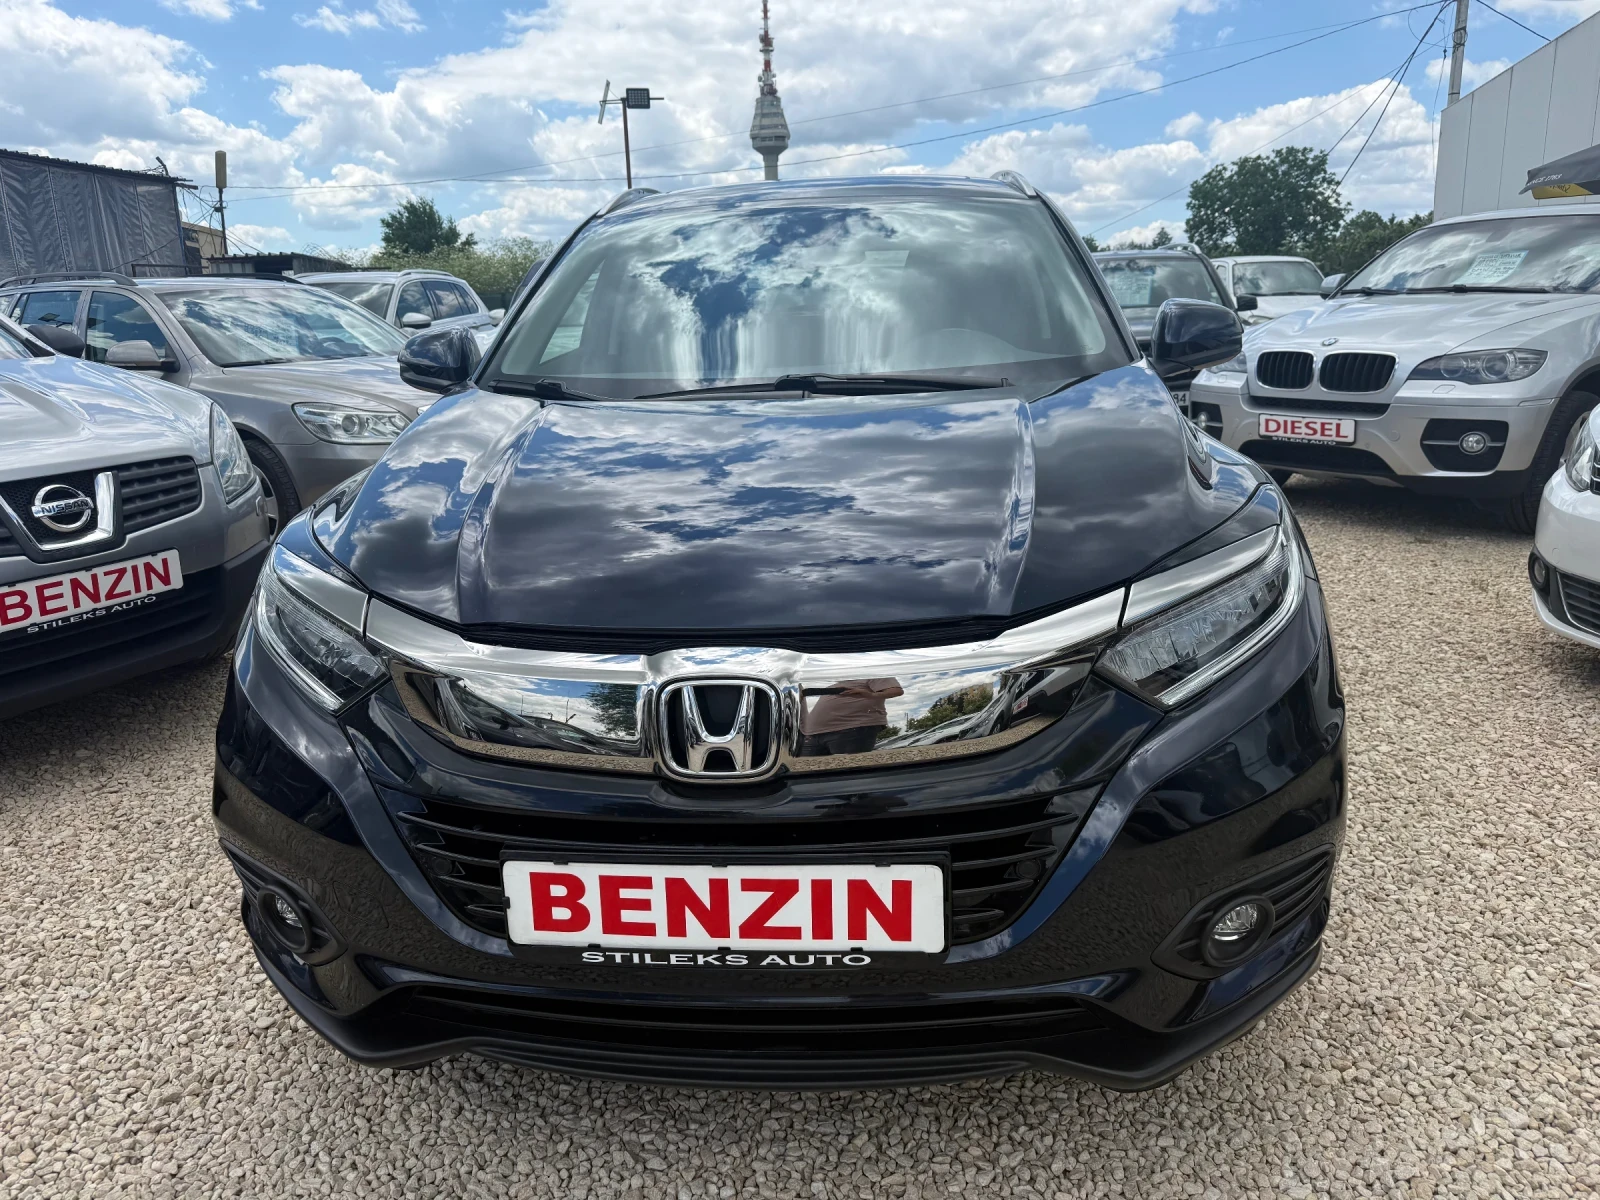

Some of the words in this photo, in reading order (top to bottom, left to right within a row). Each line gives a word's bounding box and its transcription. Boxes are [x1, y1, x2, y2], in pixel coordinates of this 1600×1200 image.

[1264, 418, 1348, 439] DIESEL
[41, 499, 89, 514] NISSAN
[0, 557, 172, 626] BENZIN
[27, 608, 106, 633] STILEKS
[111, 595, 156, 612] AUTO
[529, 872, 912, 942] BENZIN
[582, 951, 749, 966] STILEKS
[760, 954, 872, 966] AUTO
